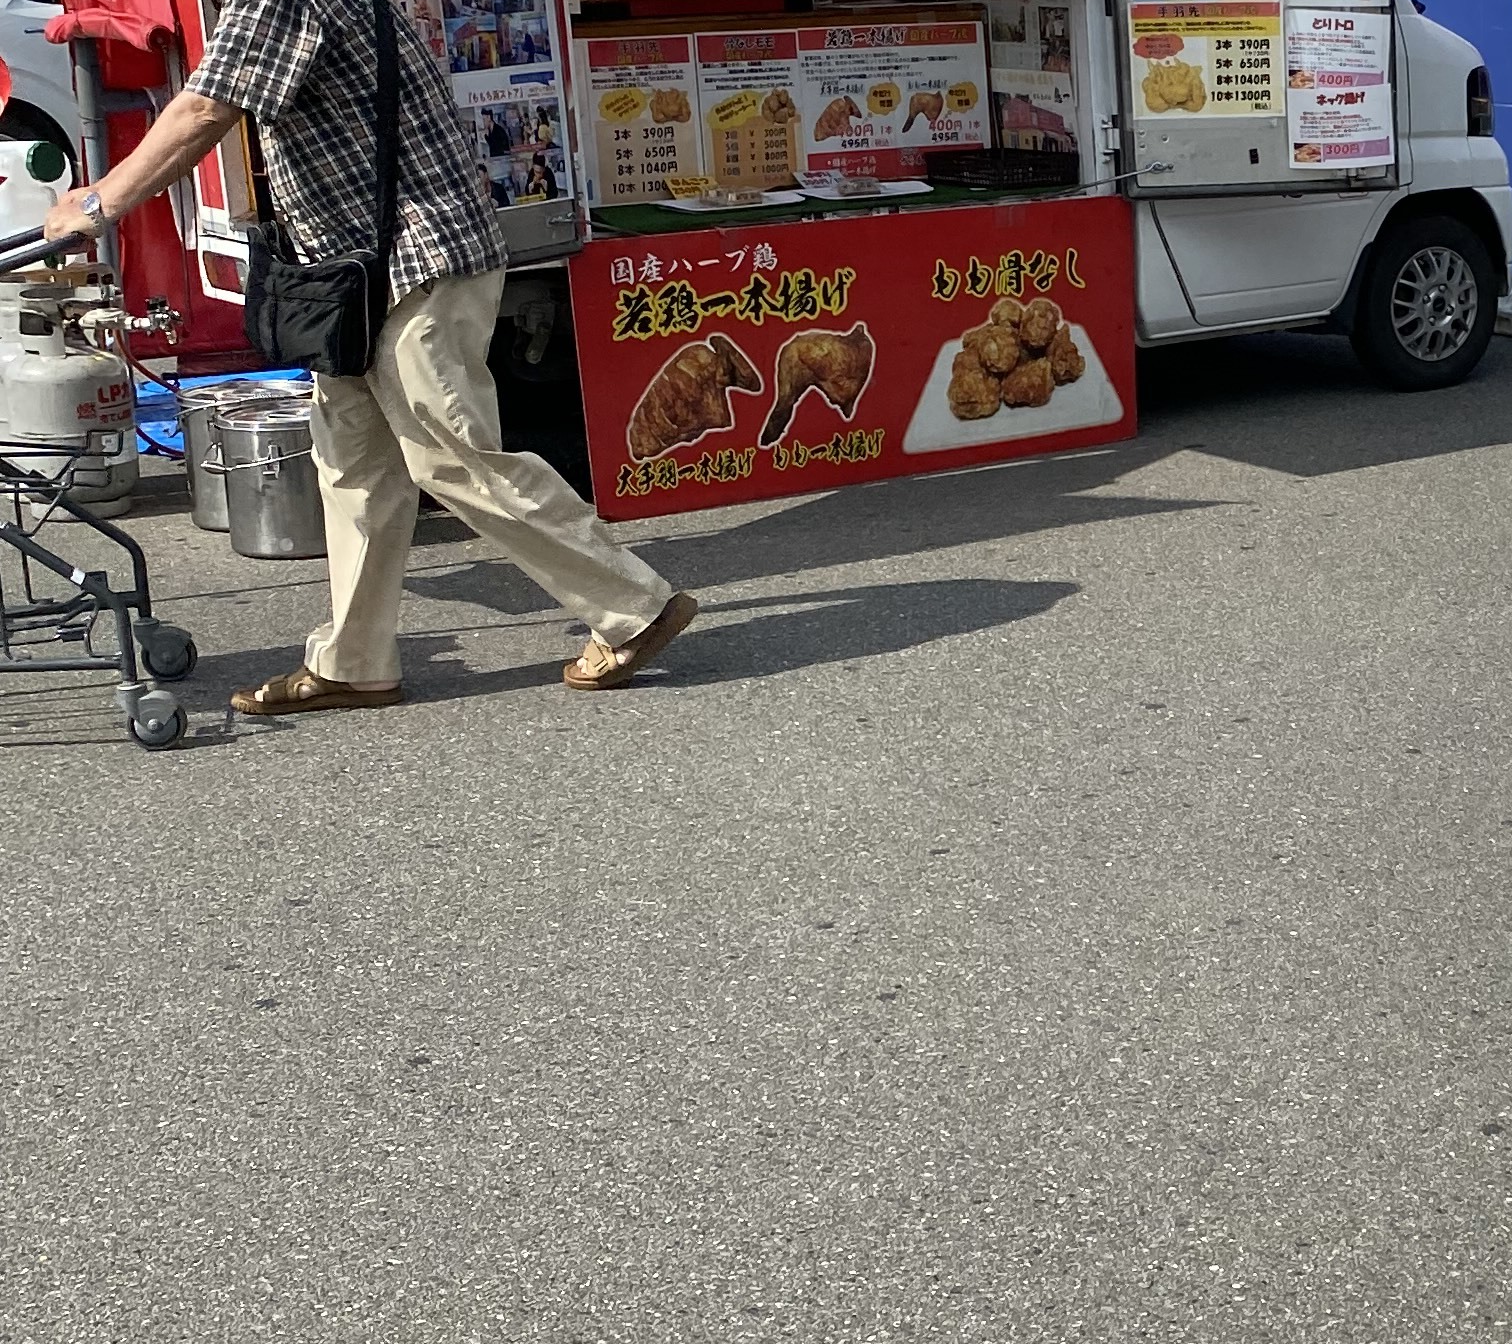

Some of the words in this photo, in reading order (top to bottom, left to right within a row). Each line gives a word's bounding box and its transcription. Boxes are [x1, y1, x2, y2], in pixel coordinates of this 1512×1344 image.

[1157, 6, 1200, 17] 手羽先
[1312, 18, 1354, 31] とりトロ
[824, 26, 908, 49] 若鶏一本揚げ
[1215, 39, 1232, 50] 3本
[1239, 39, 1270, 50] 390円
[1215, 58, 1233, 69] 5本
[1239, 58, 1271, 69] 650円
[1216, 75, 1233, 85] 8本
[1234, 74, 1271, 85] 1040円
[1318, 74, 1354, 86] 400円
[1211, 91, 1234, 102] 10本
[1234, 90, 1271, 101] 1300円
[1316, 91, 1365, 106] ネック揚げ
[928, 119, 963, 132] 400円
[614, 129, 632, 141] 3本
[642, 126, 675, 139] 390円
[931, 132, 960, 142] 495円
[764, 138, 788, 149] 500円
[841, 138, 870, 149] 495円
[1325, 143, 1360, 155] 300円
[615, 148, 634, 161] 5本
[644, 145, 677, 158] 650円
[617, 164, 636, 176] 8本
[640, 161, 678, 174] 1040円
[612, 182, 637, 195] 10本
[610, 243, 778, 286] 国産ハーブ鶏
[932, 248, 1087, 301] もも骨なし
[612, 267, 855, 342] 若鶏一本揚げ
[772, 430, 886, 471] もも一本揚げ
[615, 447, 757, 498] 大手羽一本揚げ
